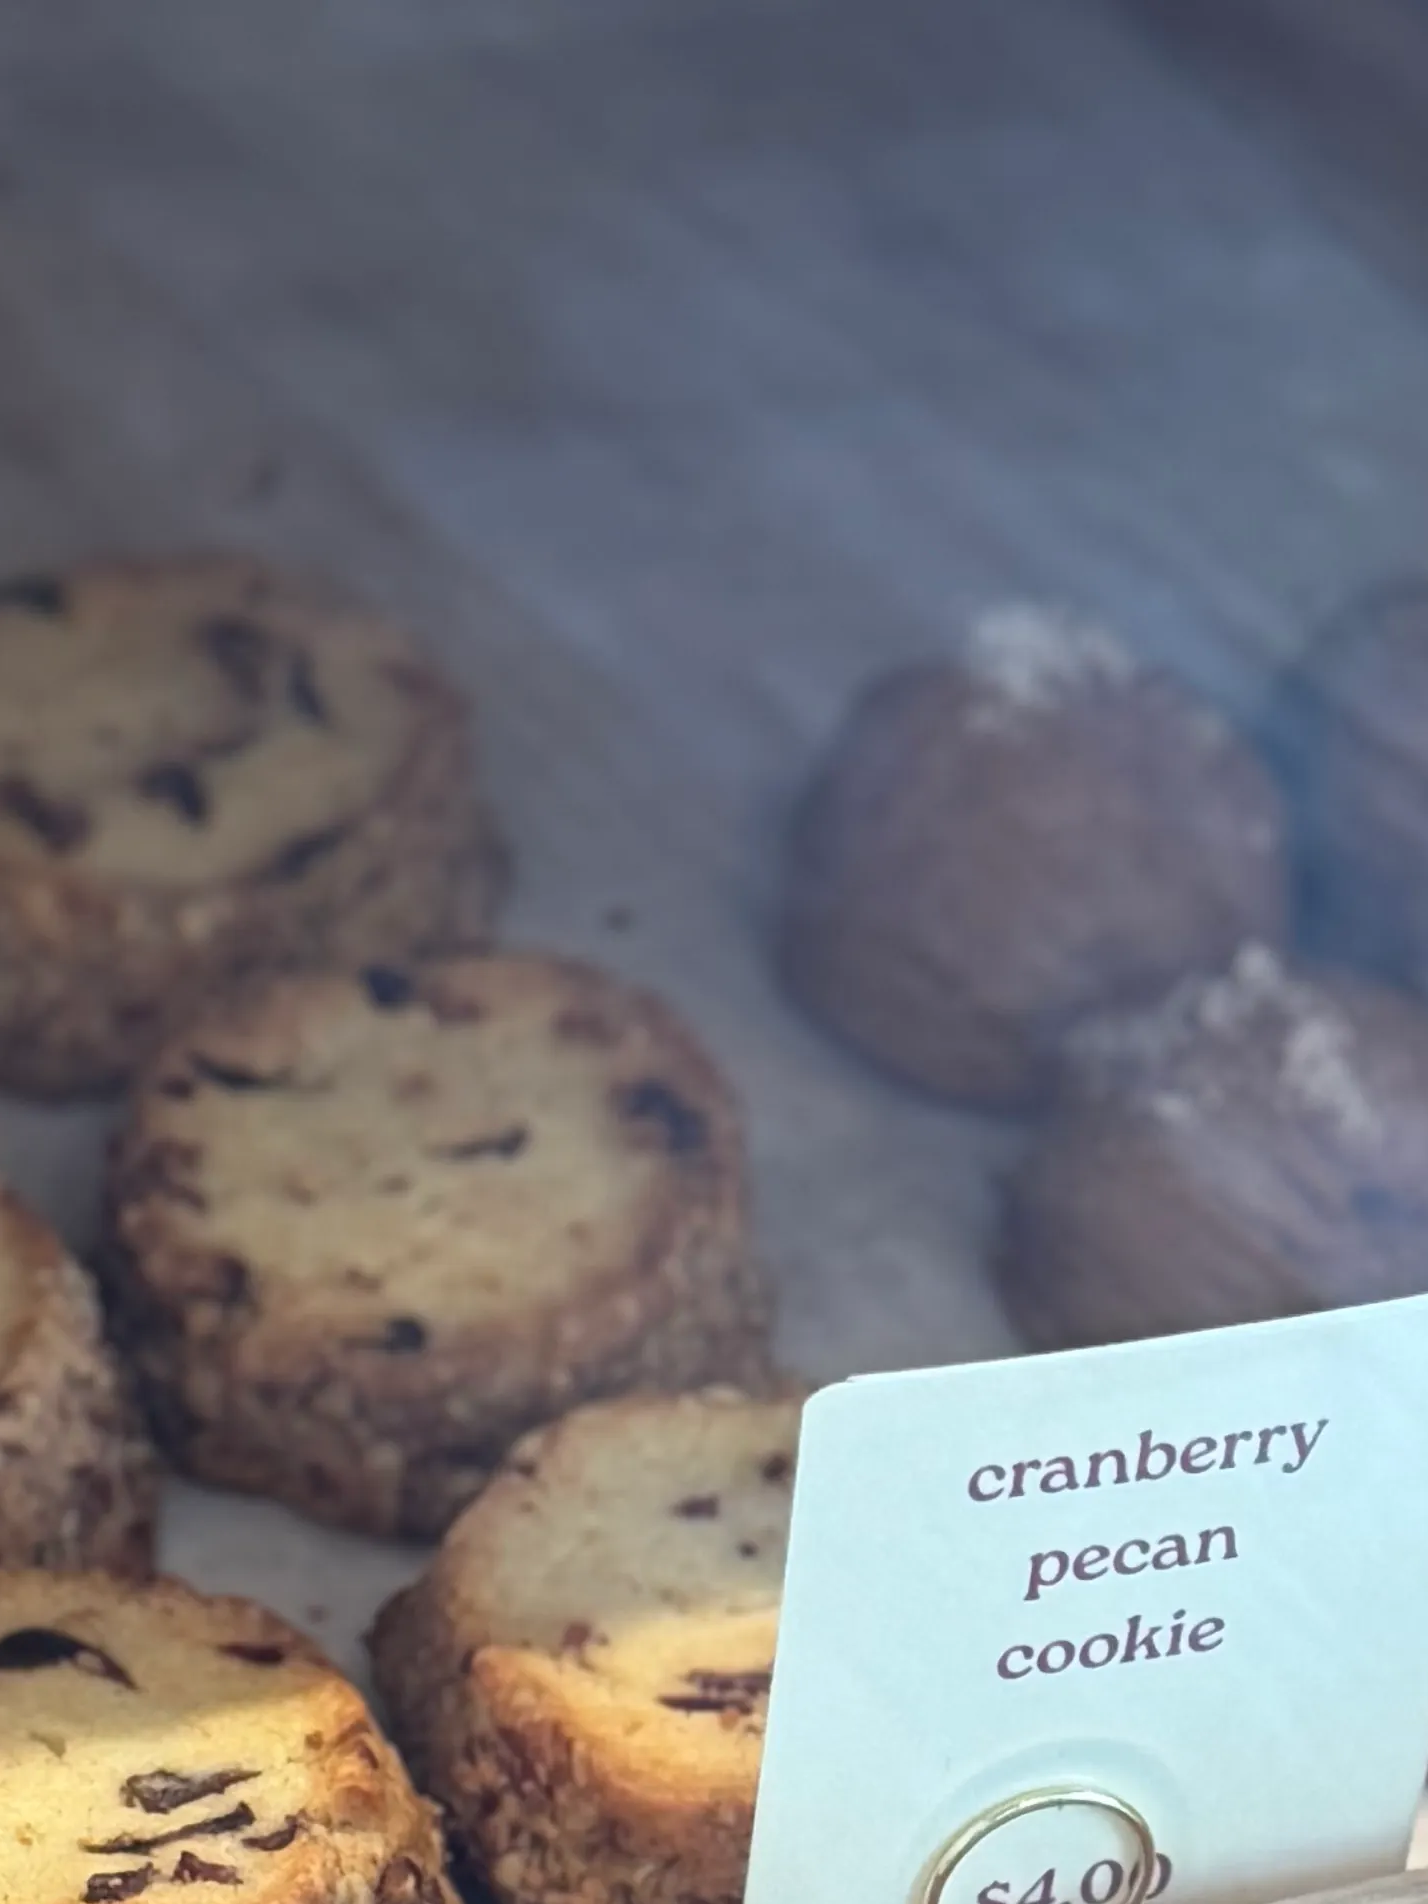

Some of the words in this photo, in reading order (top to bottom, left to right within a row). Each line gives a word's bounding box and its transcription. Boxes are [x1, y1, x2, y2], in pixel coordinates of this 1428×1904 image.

[967, 1418, 1329, 1503] cranberry
[1023, 1525, 1239, 1602] pecan
[996, 1609, 1226, 1680] cookie
